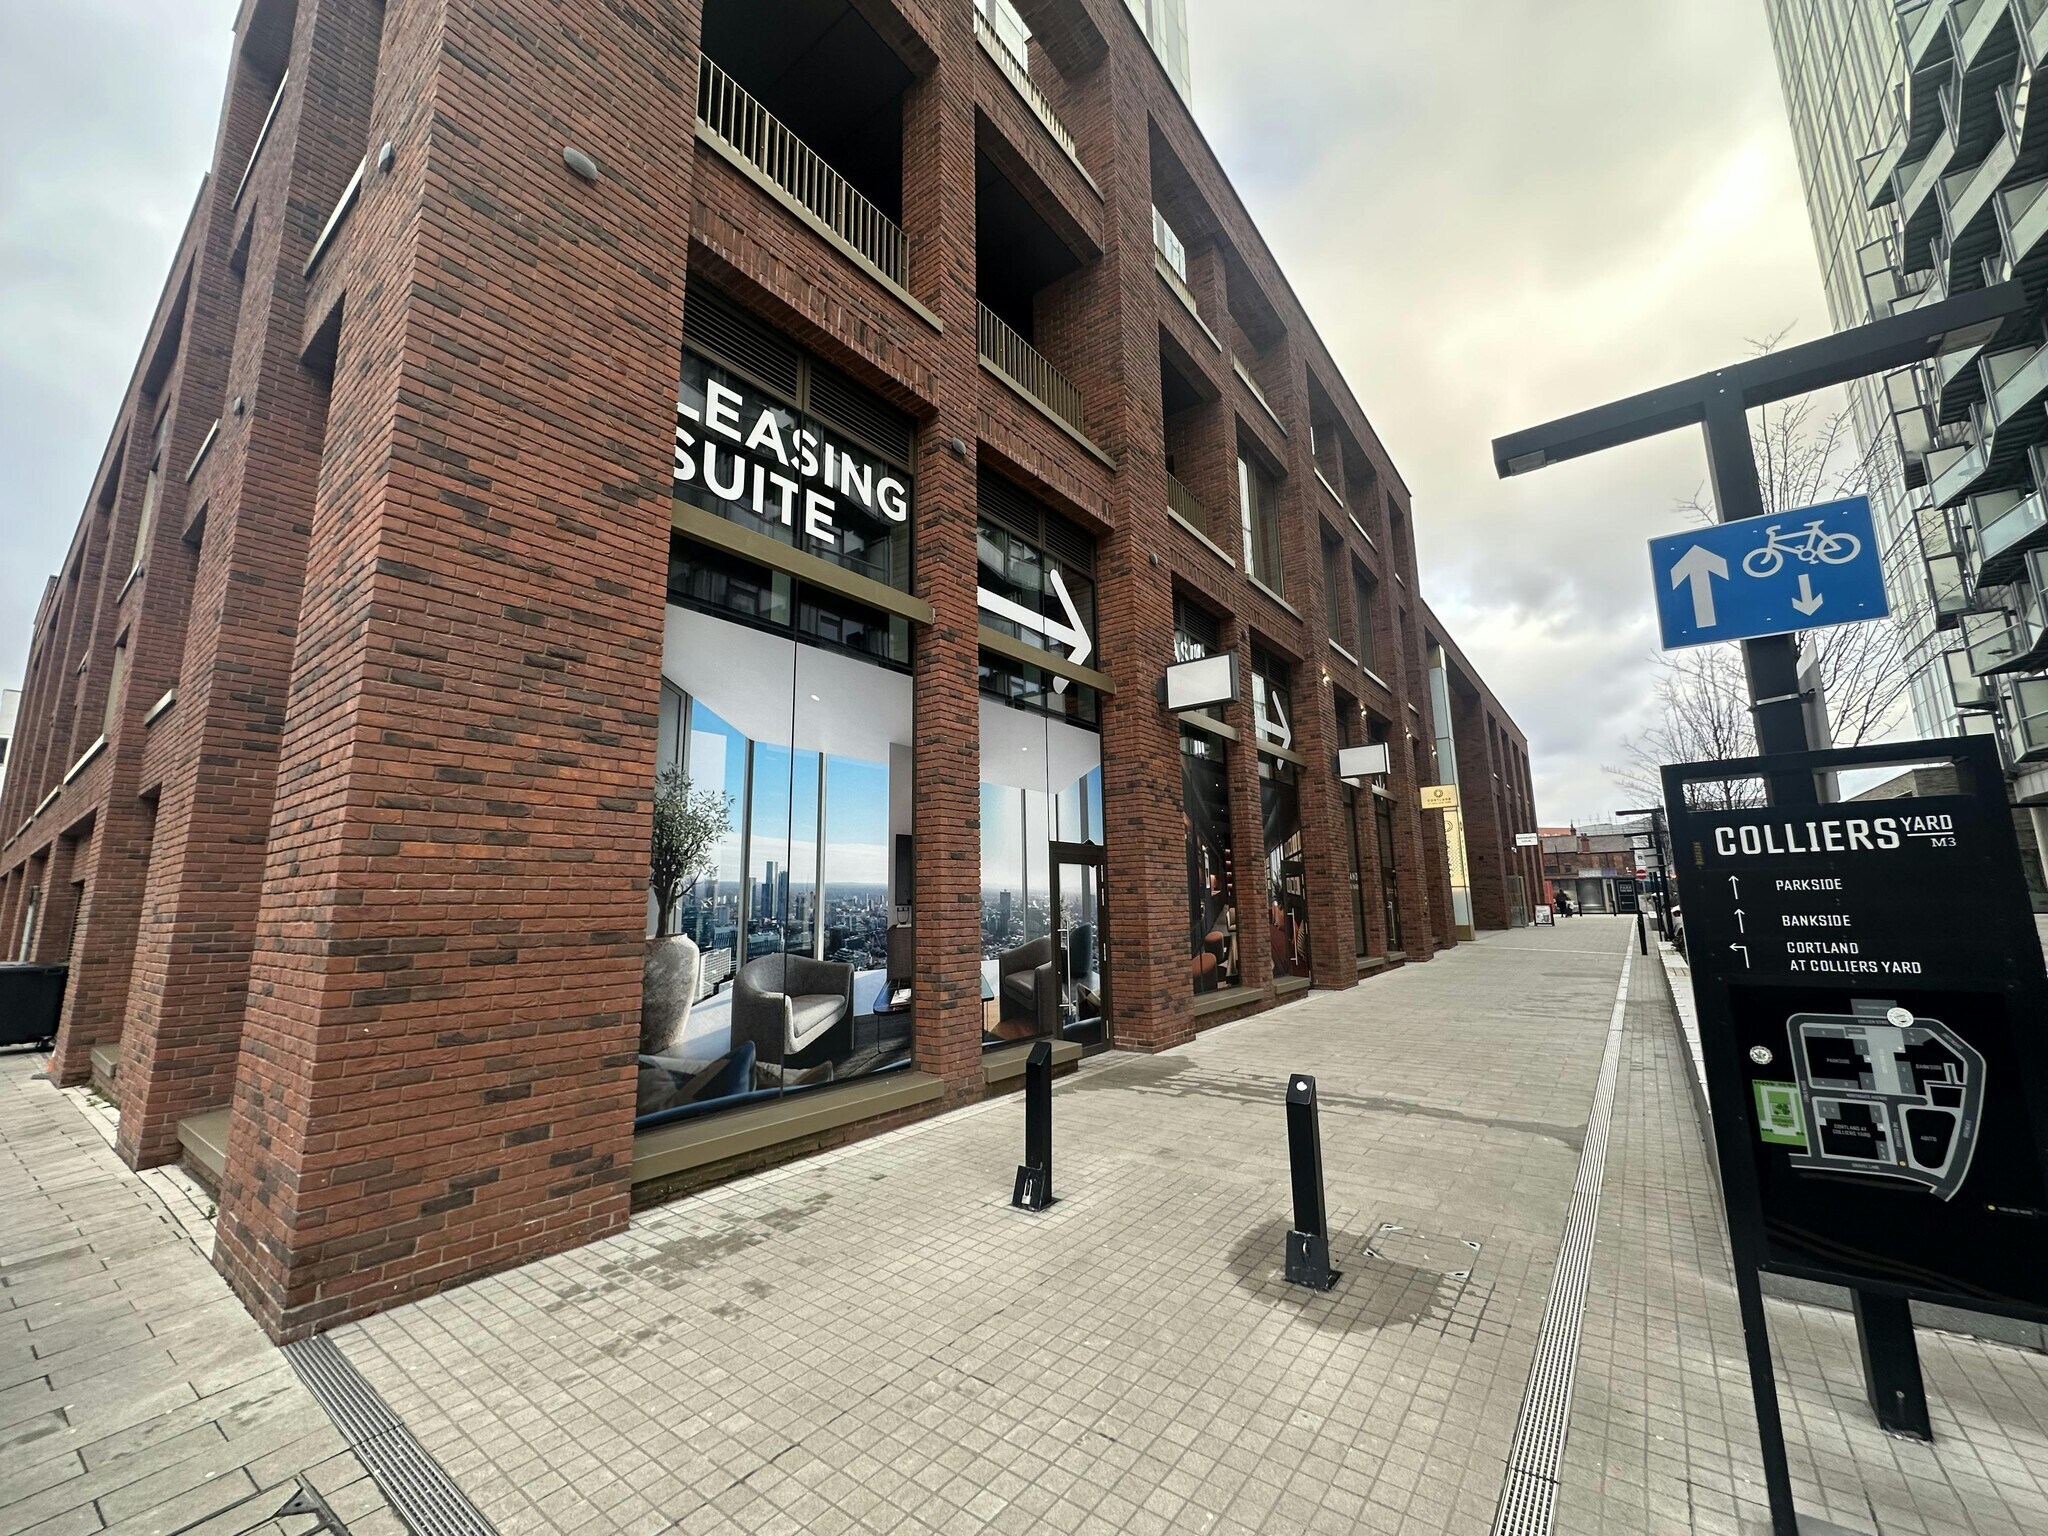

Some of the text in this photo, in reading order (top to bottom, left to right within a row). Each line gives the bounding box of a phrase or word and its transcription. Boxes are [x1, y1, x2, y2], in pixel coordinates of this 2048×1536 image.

[1714, 817, 1900, 857] COLLIERS
[1900, 814, 1953, 832] YARD
[1931, 837, 1957, 848] M3
[1775, 878, 1843, 892] PARKSIDE
[1781, 914, 1852, 928] BANKSIDE
[1786, 941, 1859, 955] CORTLAND
[1790, 959, 1922, 975] AT COLLIERS YARD
